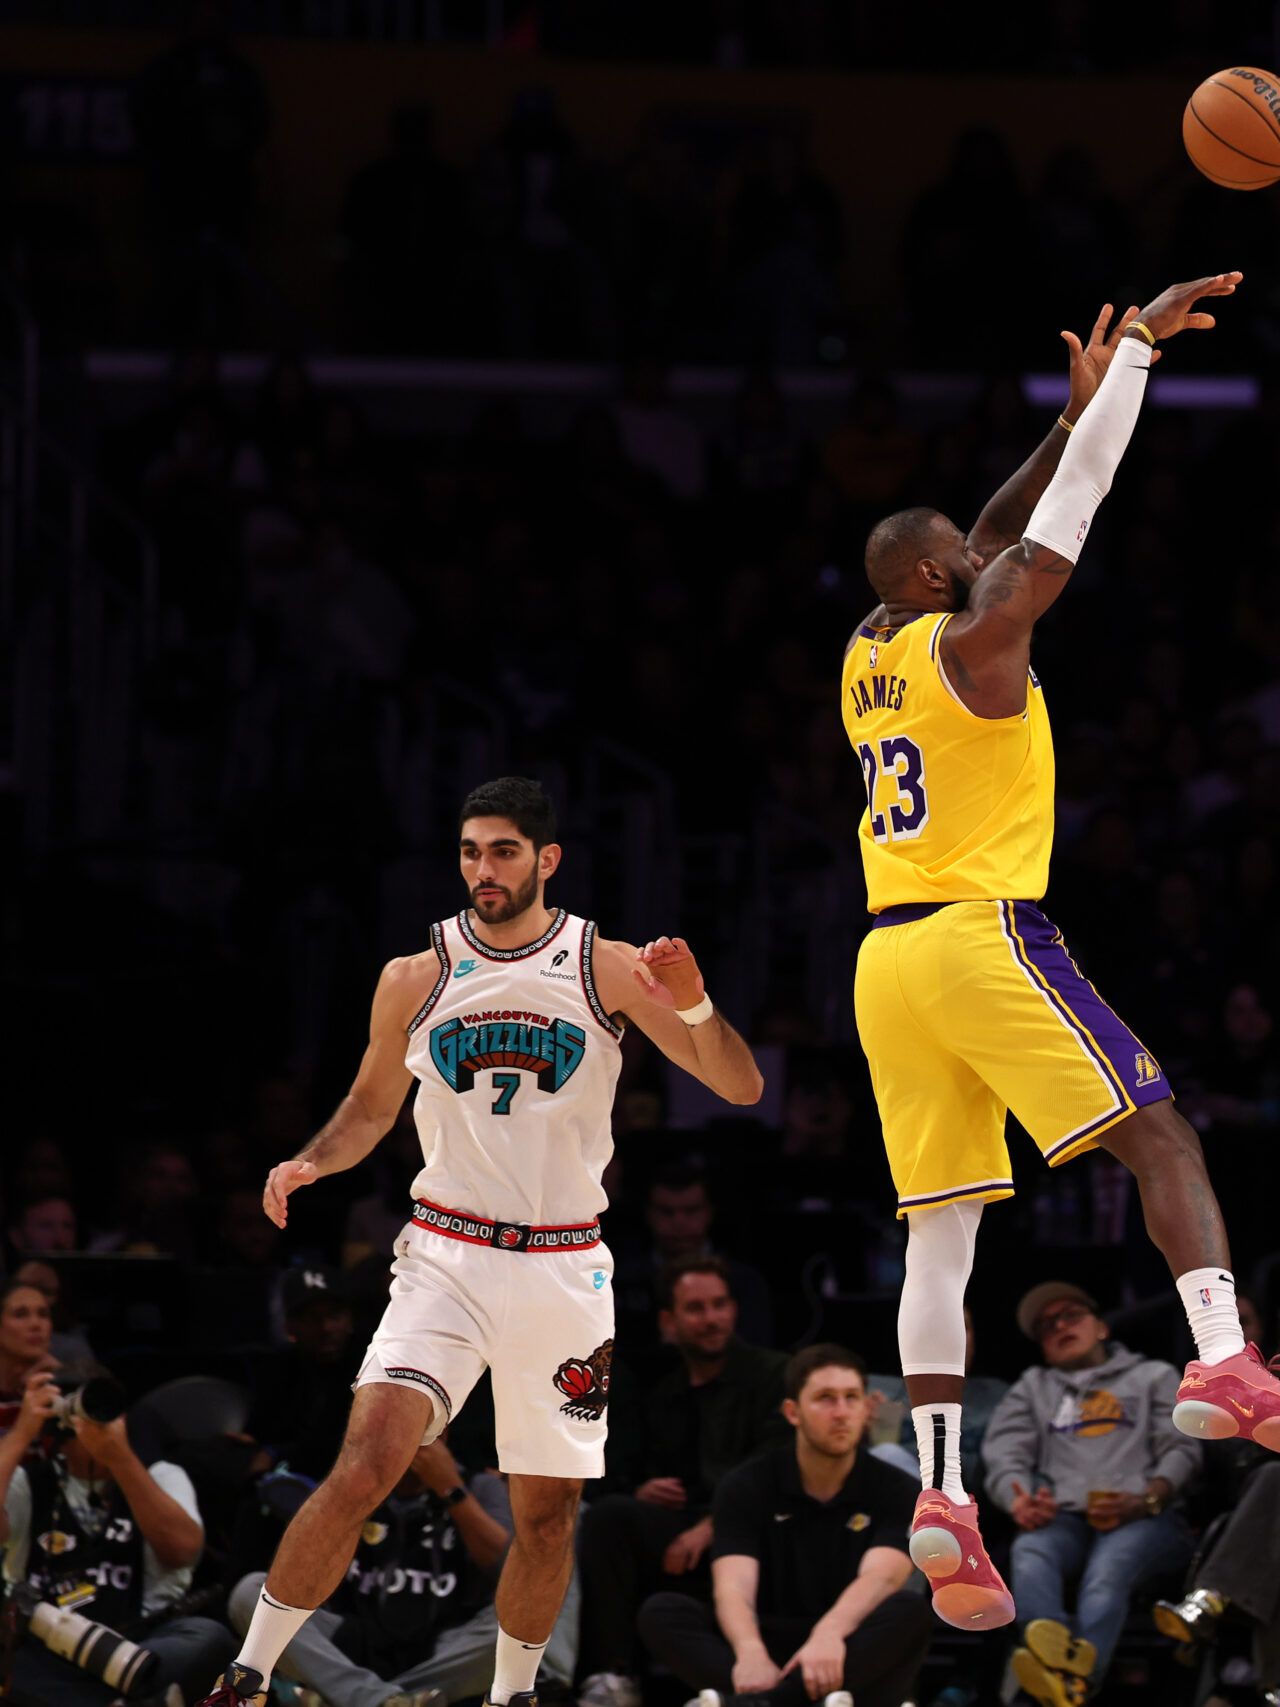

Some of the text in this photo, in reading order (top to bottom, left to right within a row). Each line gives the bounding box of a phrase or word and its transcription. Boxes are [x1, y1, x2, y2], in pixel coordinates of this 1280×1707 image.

[851, 675, 907, 718] JAMES
[857, 734, 930, 844] 23
[540, 969, 577, 981] Robinhood
[463, 1010, 550, 1027] VANCOUVER
[429, 1017, 586, 1094] GRIZZLIES
[491, 1072, 521, 1116] 7
